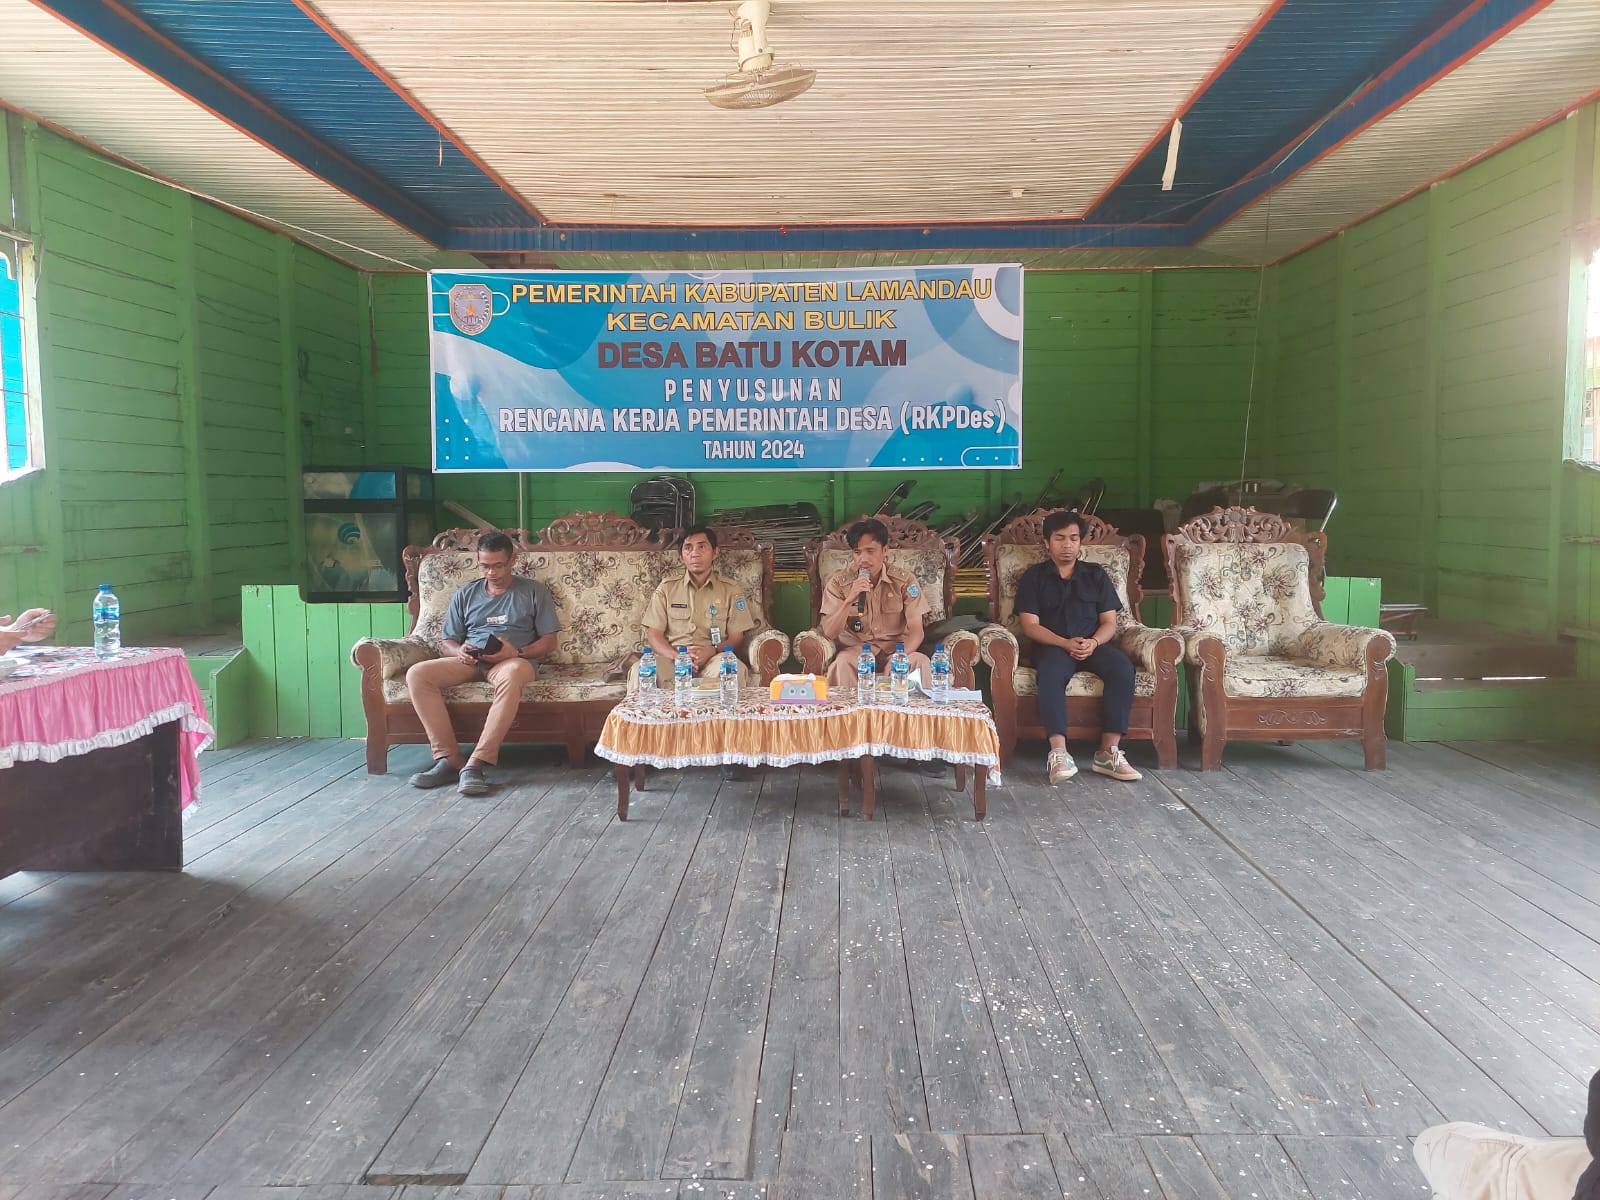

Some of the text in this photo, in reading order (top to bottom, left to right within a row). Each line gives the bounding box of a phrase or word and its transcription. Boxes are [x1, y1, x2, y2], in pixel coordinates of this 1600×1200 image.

[511, 278, 992, 304] PEMERINTAH KABUPATEN LAMANDAU
[607, 309, 898, 332] KECAMATAN BULIK
[597, 340, 907, 368] DESA BATU KOTAM
[664, 377, 842, 402] PENYUSUNAN
[499, 399, 1006, 435] RENCANA KERJA PEMERINTAH DESA (RKPDes)
[702, 439, 805, 460] TAHUN 2024
